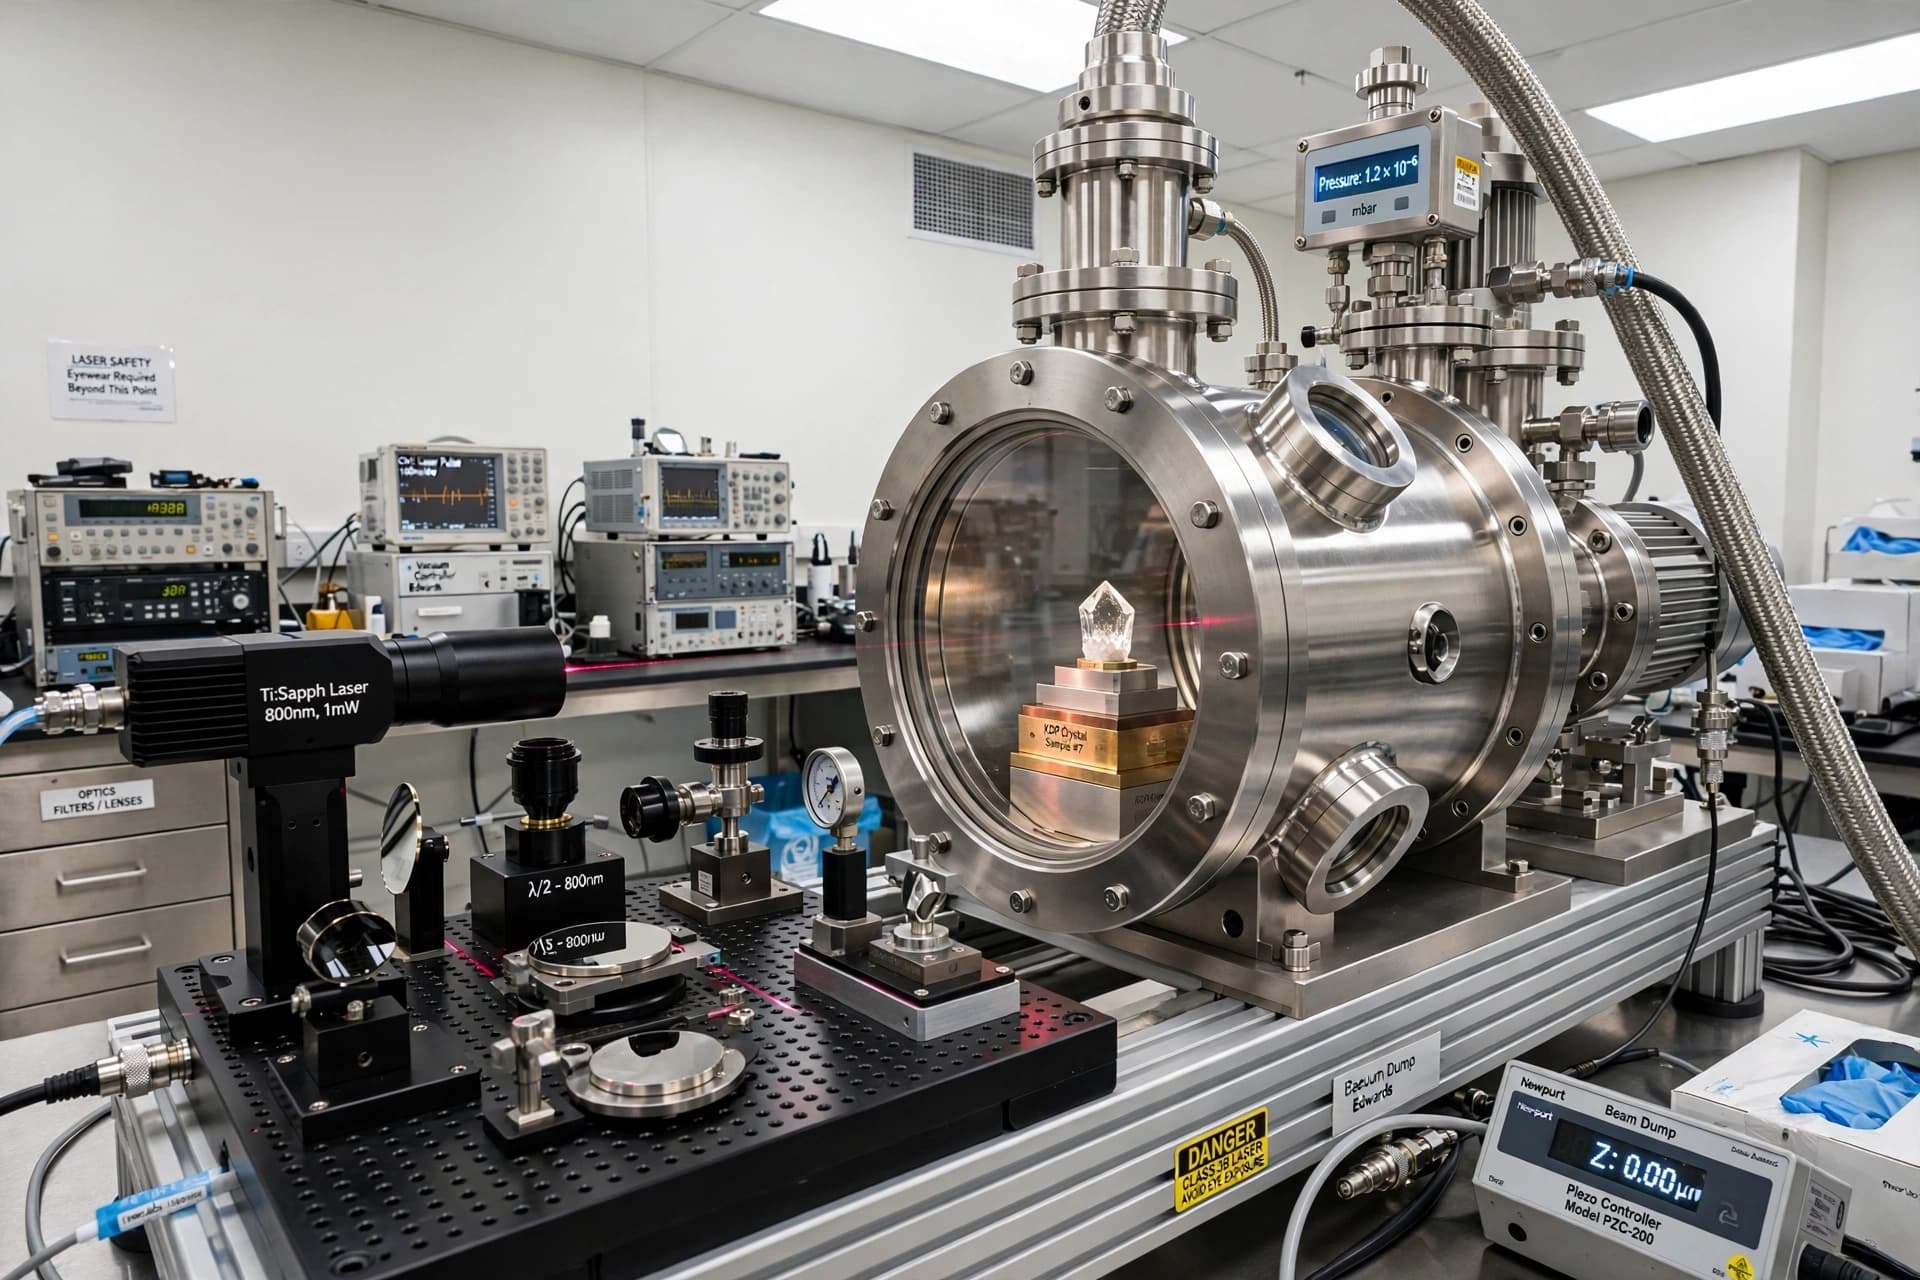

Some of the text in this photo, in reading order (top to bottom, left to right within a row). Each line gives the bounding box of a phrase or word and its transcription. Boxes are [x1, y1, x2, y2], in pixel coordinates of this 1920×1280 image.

[1319, 172, 1362, 193] Pressure:
[1365, 165, 1381, 183] 1.2
[1352, 203, 1377, 217] mbar
[72, 354, 152, 368] LASER SAFETY
[67, 368, 156, 384] Eyewear Required
[67, 382, 157, 396] Beyond This Point
[259, 682, 369, 703] Ti:Sapph Laser
[264, 699, 360, 723] 800nm, 1mW
[1061, 725, 1088, 742] Crystal
[78, 786, 116, 800] OPTICS
[53, 801, 95, 815] FILTERS
[104, 795, 143, 810] LENSES
[564, 873, 604, 891] 800nm
[1386, 1055, 1416, 1077] Dump
[1352, 1082, 1393, 1113] Edwards
[1604, 1104, 1677, 1141] Beam Dump
[1188, 1119, 1257, 1171] DANGER
[1182, 1163, 1216, 1191] CLASS
[1231, 1140, 1263, 1167] LASER
[1564, 1199, 1655, 1245] Model PZC-200
[1600, 1197, 1662, 1231] Controller
